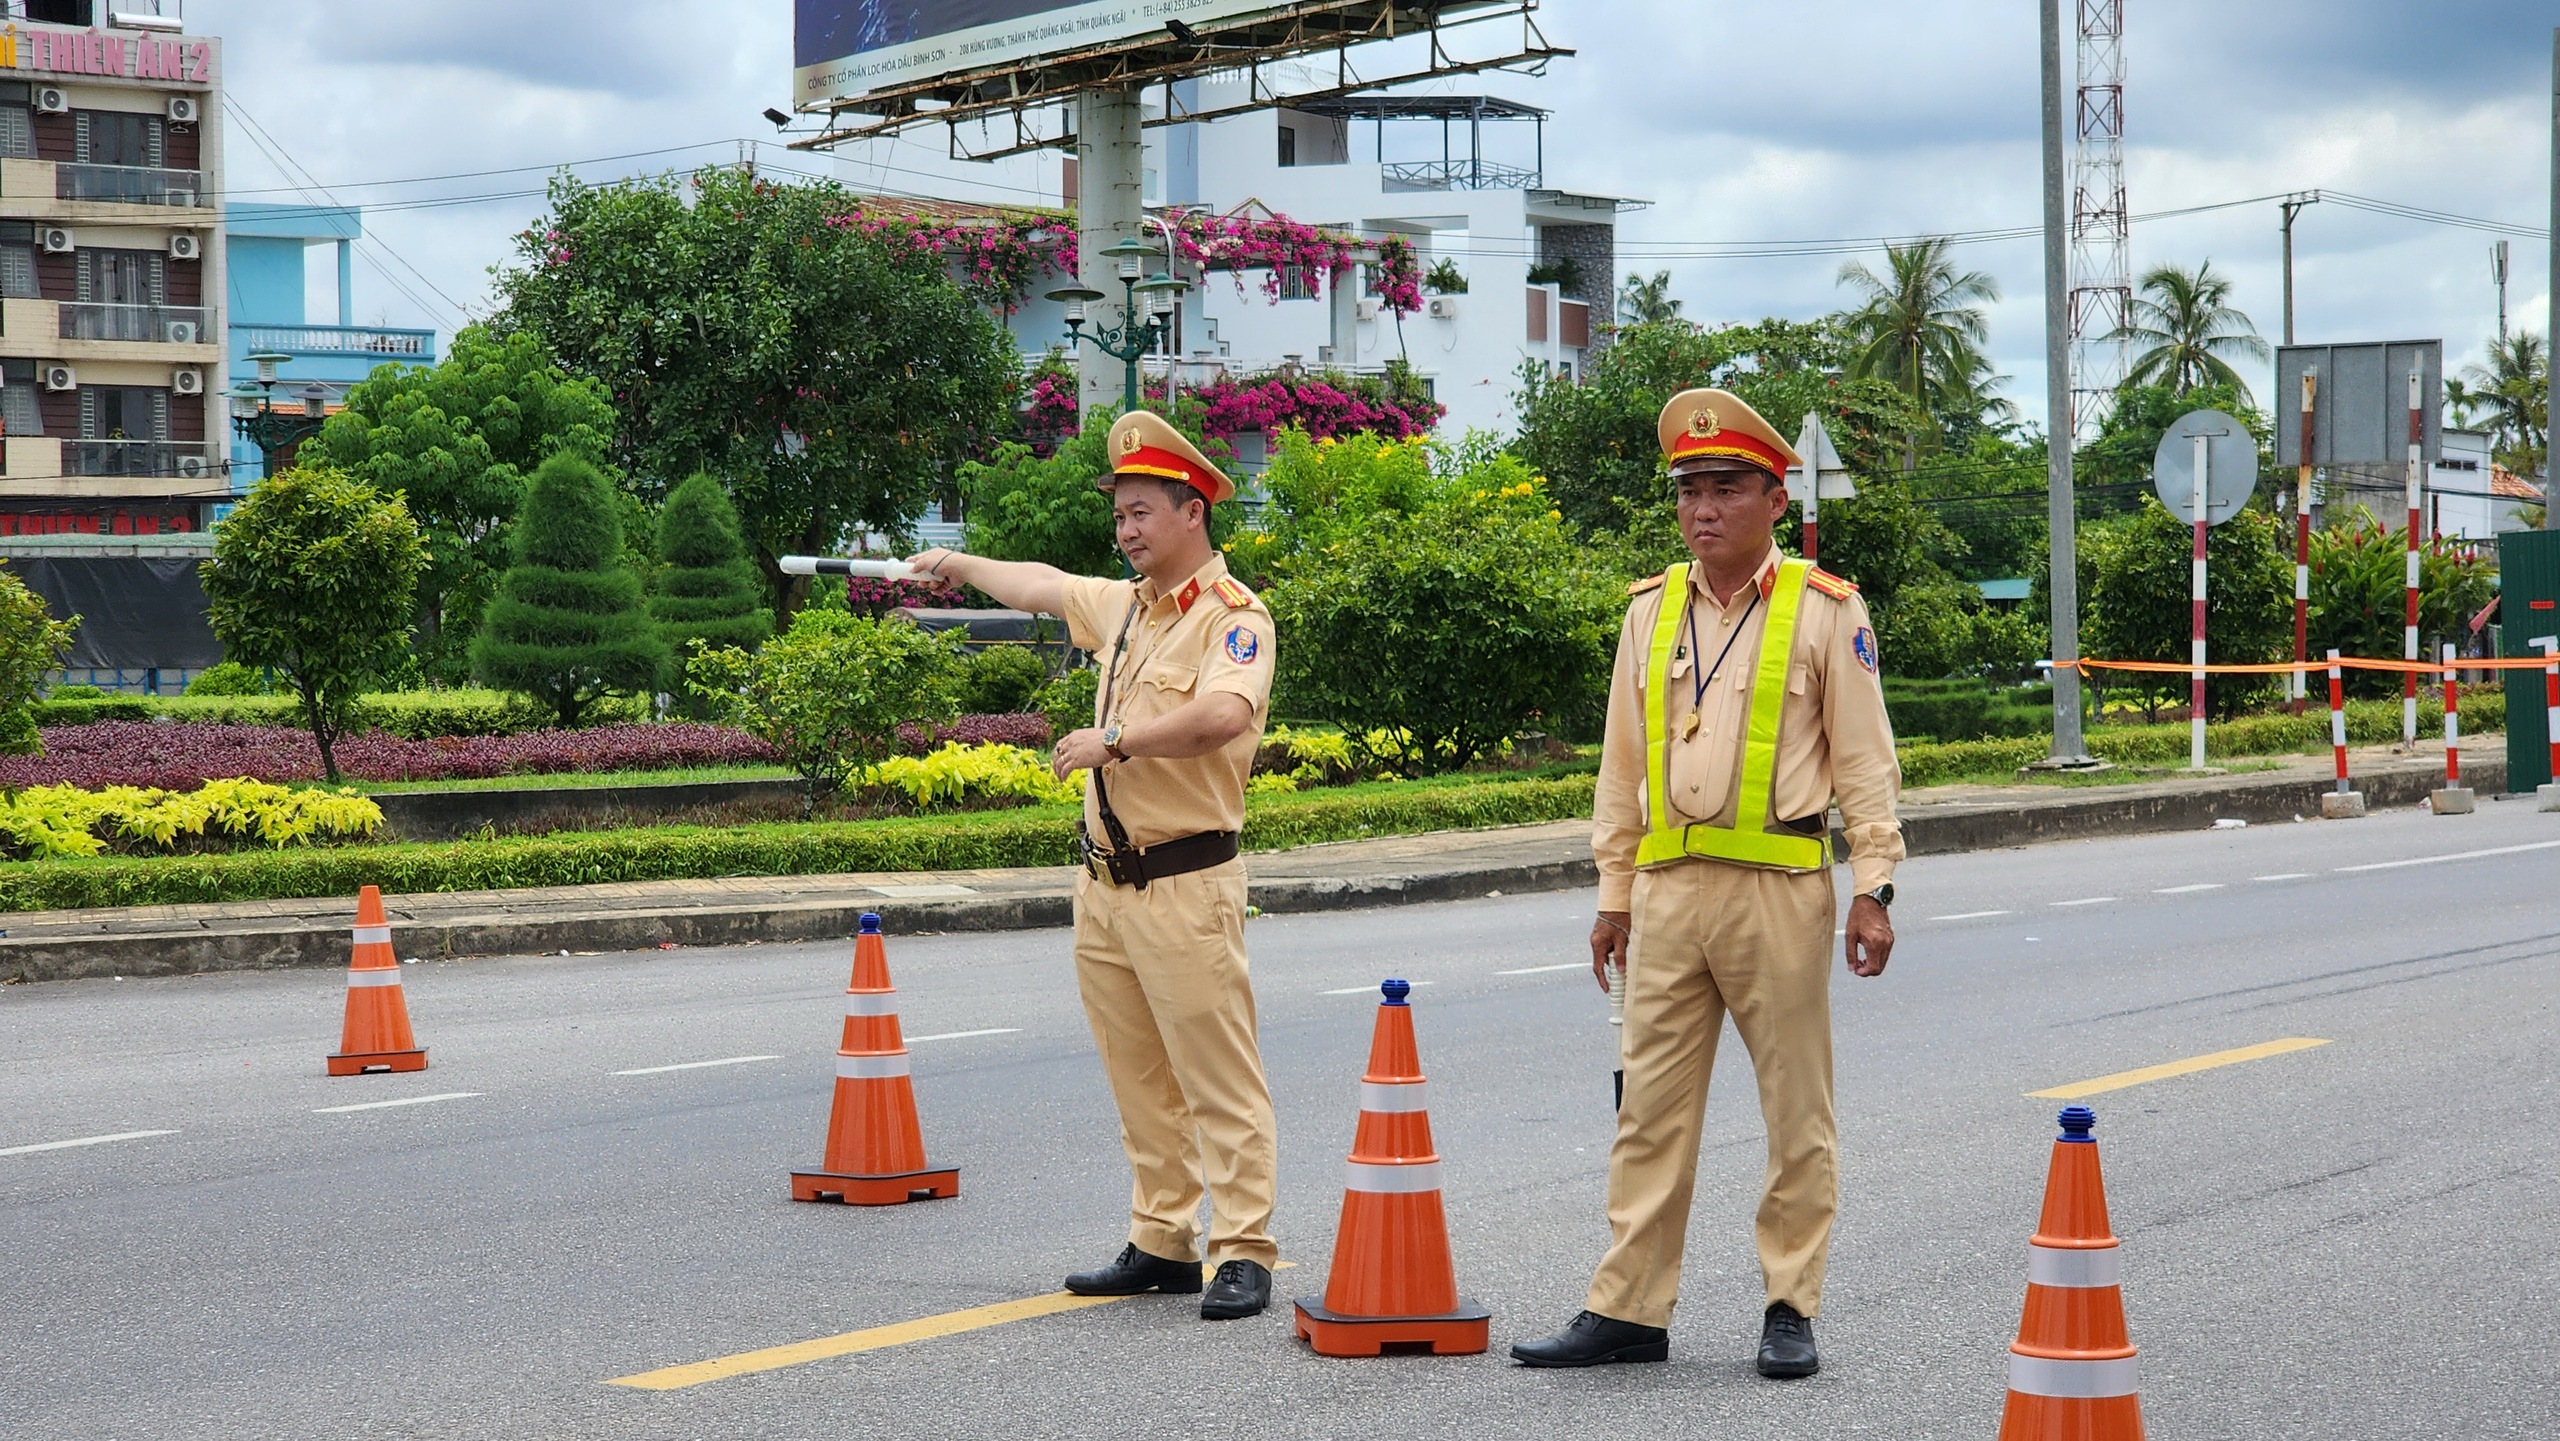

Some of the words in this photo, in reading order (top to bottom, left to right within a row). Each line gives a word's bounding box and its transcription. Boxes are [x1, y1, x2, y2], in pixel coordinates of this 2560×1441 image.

[27, 26, 125, 76] THIÊN
[136, 30, 182, 80] ÂN
[191, 43, 211, 82] 2
[808, 75, 827, 89] CÔNG
[828, 73, 836, 85] TY
[868, 63, 880, 78] LỌC
[881, 58, 896, 73] HÓA
[913, 52, 930, 66] BÌNH
[931, 48, 946, 62] SƠN
[1007, 31, 1026, 46] THÀNH
[1027, 25, 1039, 42] PHỐ
[1040, 22, 1059, 40] QUẢNG
[1091, 13, 1111, 30] QUẢNG
[1111, 10, 1126, 24] NGÃI
